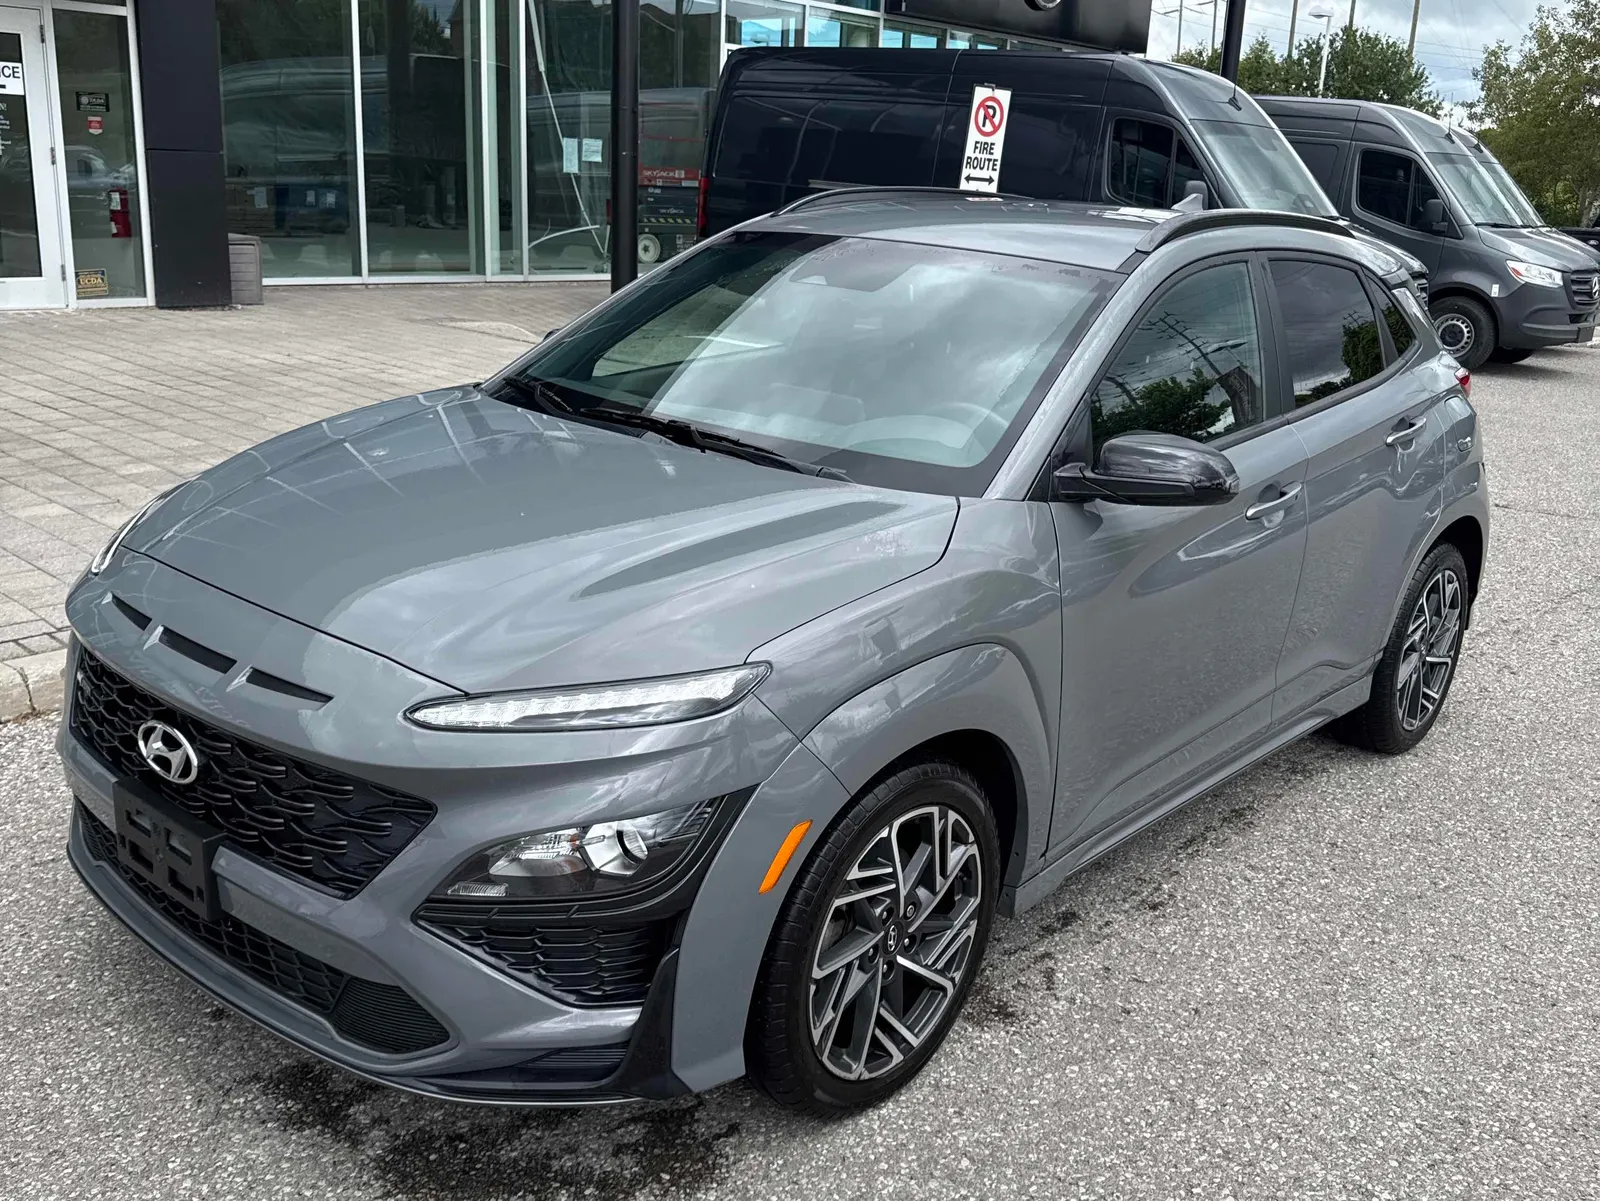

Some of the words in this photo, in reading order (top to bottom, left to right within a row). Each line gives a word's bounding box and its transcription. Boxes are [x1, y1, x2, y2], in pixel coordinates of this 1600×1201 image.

[0, 65, 20, 78] CE
[973, 141, 995, 155] FIRE
[965, 156, 998, 171] ROUTE
[643, 169, 675, 177] SKYJACK
[80, 277, 102, 285] UCDA
